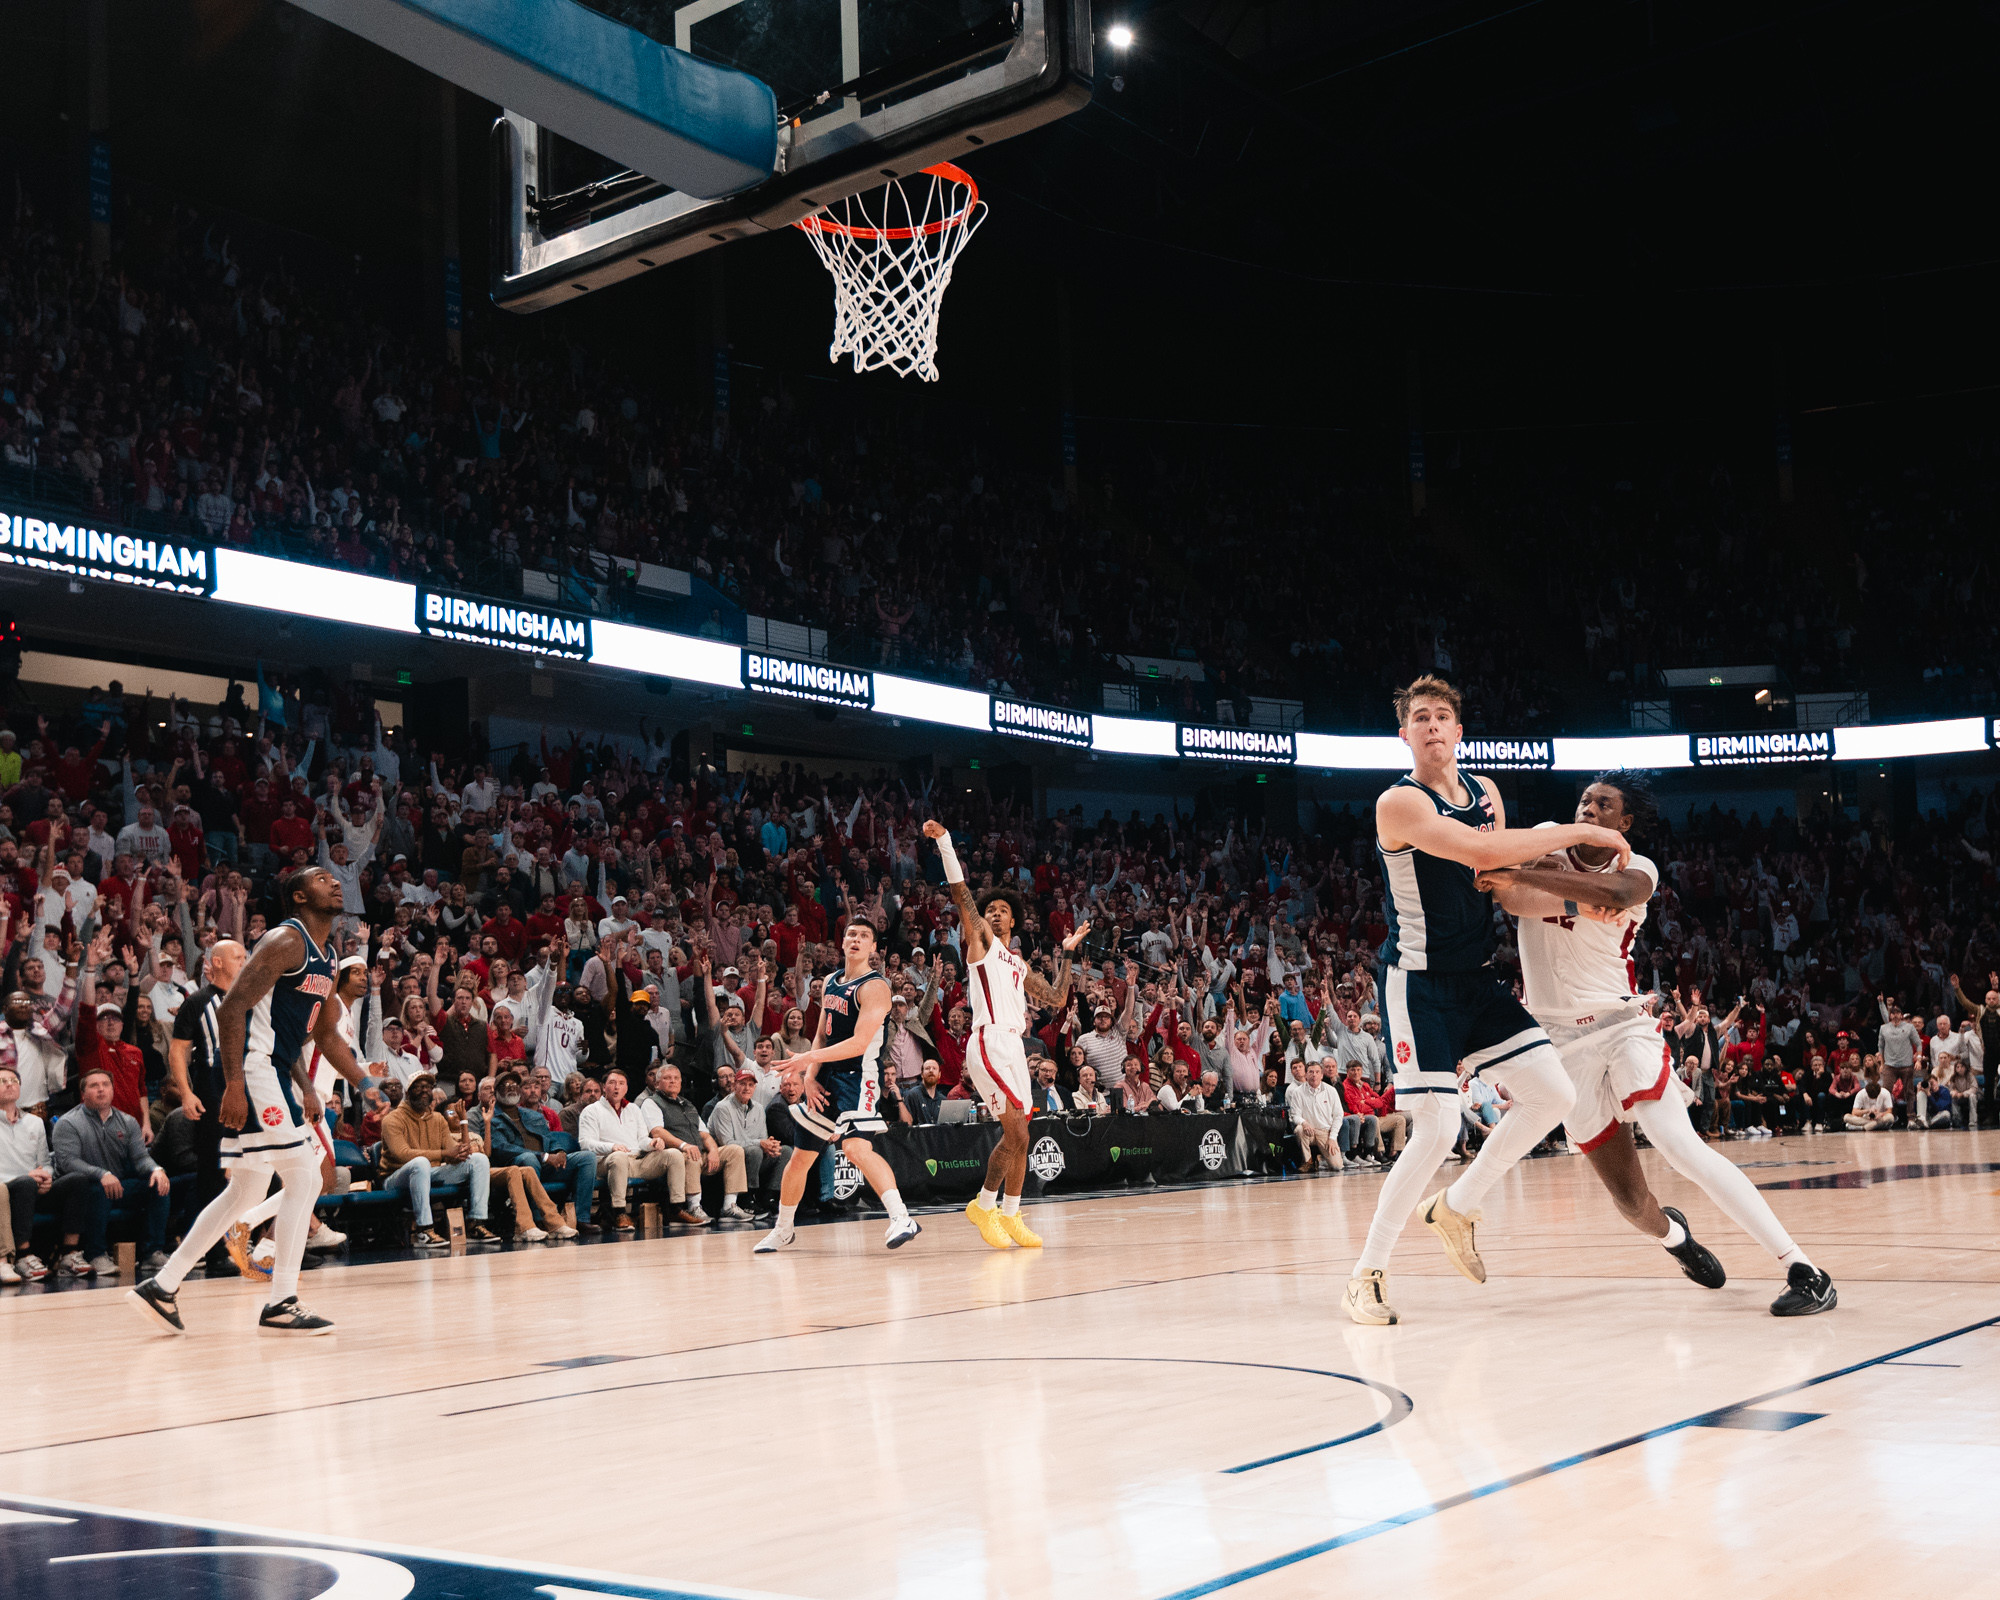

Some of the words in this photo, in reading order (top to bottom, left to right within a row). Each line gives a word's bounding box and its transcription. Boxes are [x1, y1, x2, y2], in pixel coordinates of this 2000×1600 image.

[425, 594, 585, 647] BIRMINGHAM
[748, 654, 869, 697] BIRMINGHAM
[995, 700, 1089, 737] BIRMINGHAM
[1182, 727, 1292, 754] BIRMINGHAM
[1454, 741, 1549, 760] MINGHAM
[1697, 732, 1829, 756] BIRMINGHAM
[306, 1001, 321, 1034] 0
[826, 1012, 833, 1036] 8
[1576, 1015, 1595, 1025] RTR
[561, 1032, 570, 1049] 0
[865, 1080, 875, 1112] CATS
[990, 1092, 1001, 1112] A
[1030, 1152, 1064, 1169] NEWTON
[834, 1167, 862, 1183] WTON
